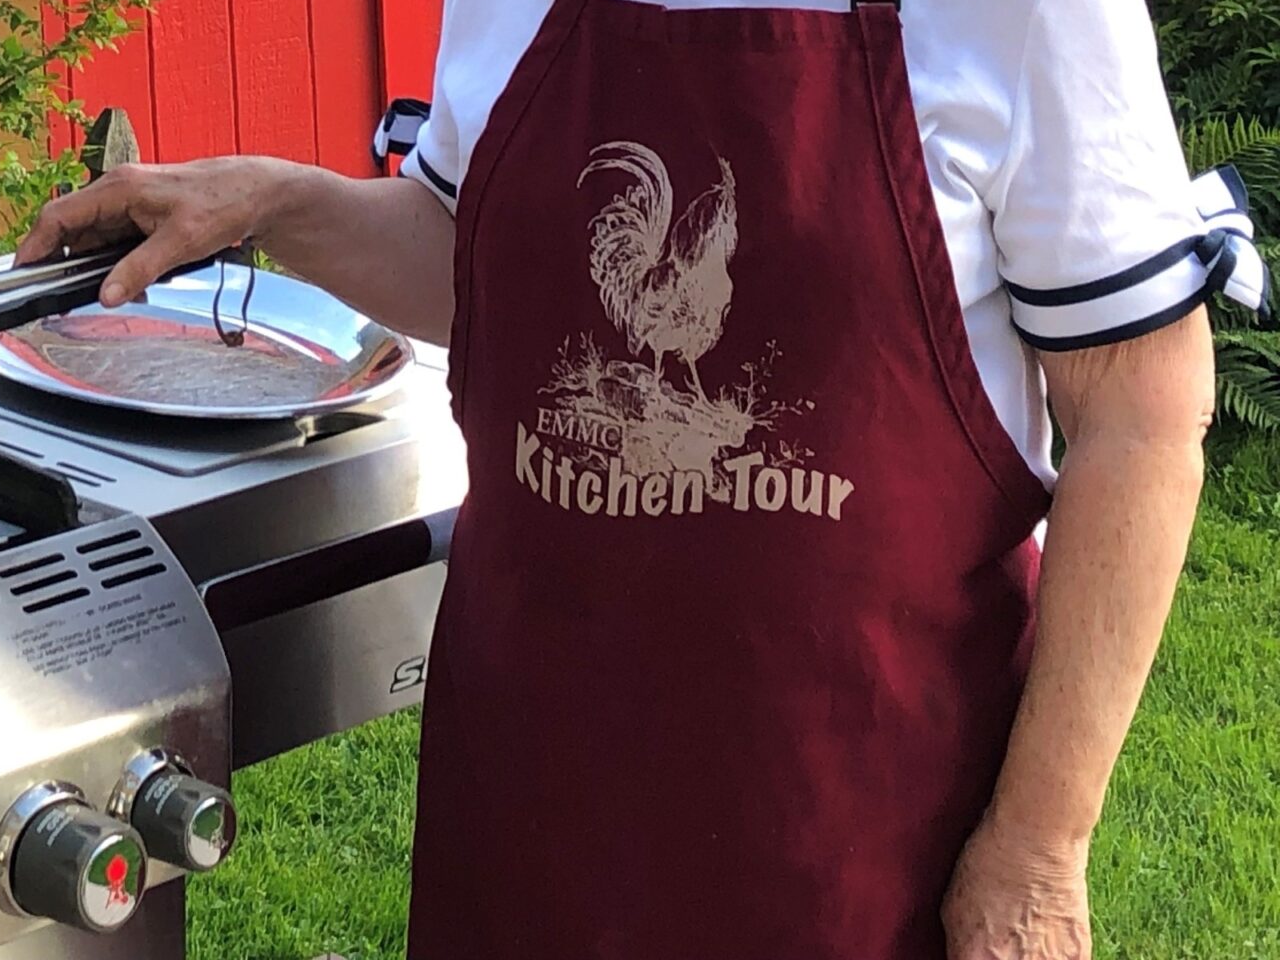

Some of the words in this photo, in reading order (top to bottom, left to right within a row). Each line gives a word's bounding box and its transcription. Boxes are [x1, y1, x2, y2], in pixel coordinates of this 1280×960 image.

[516, 421, 704, 517] Kitchen
[722, 451, 855, 521] Tour
[389, 655, 427, 694] S
